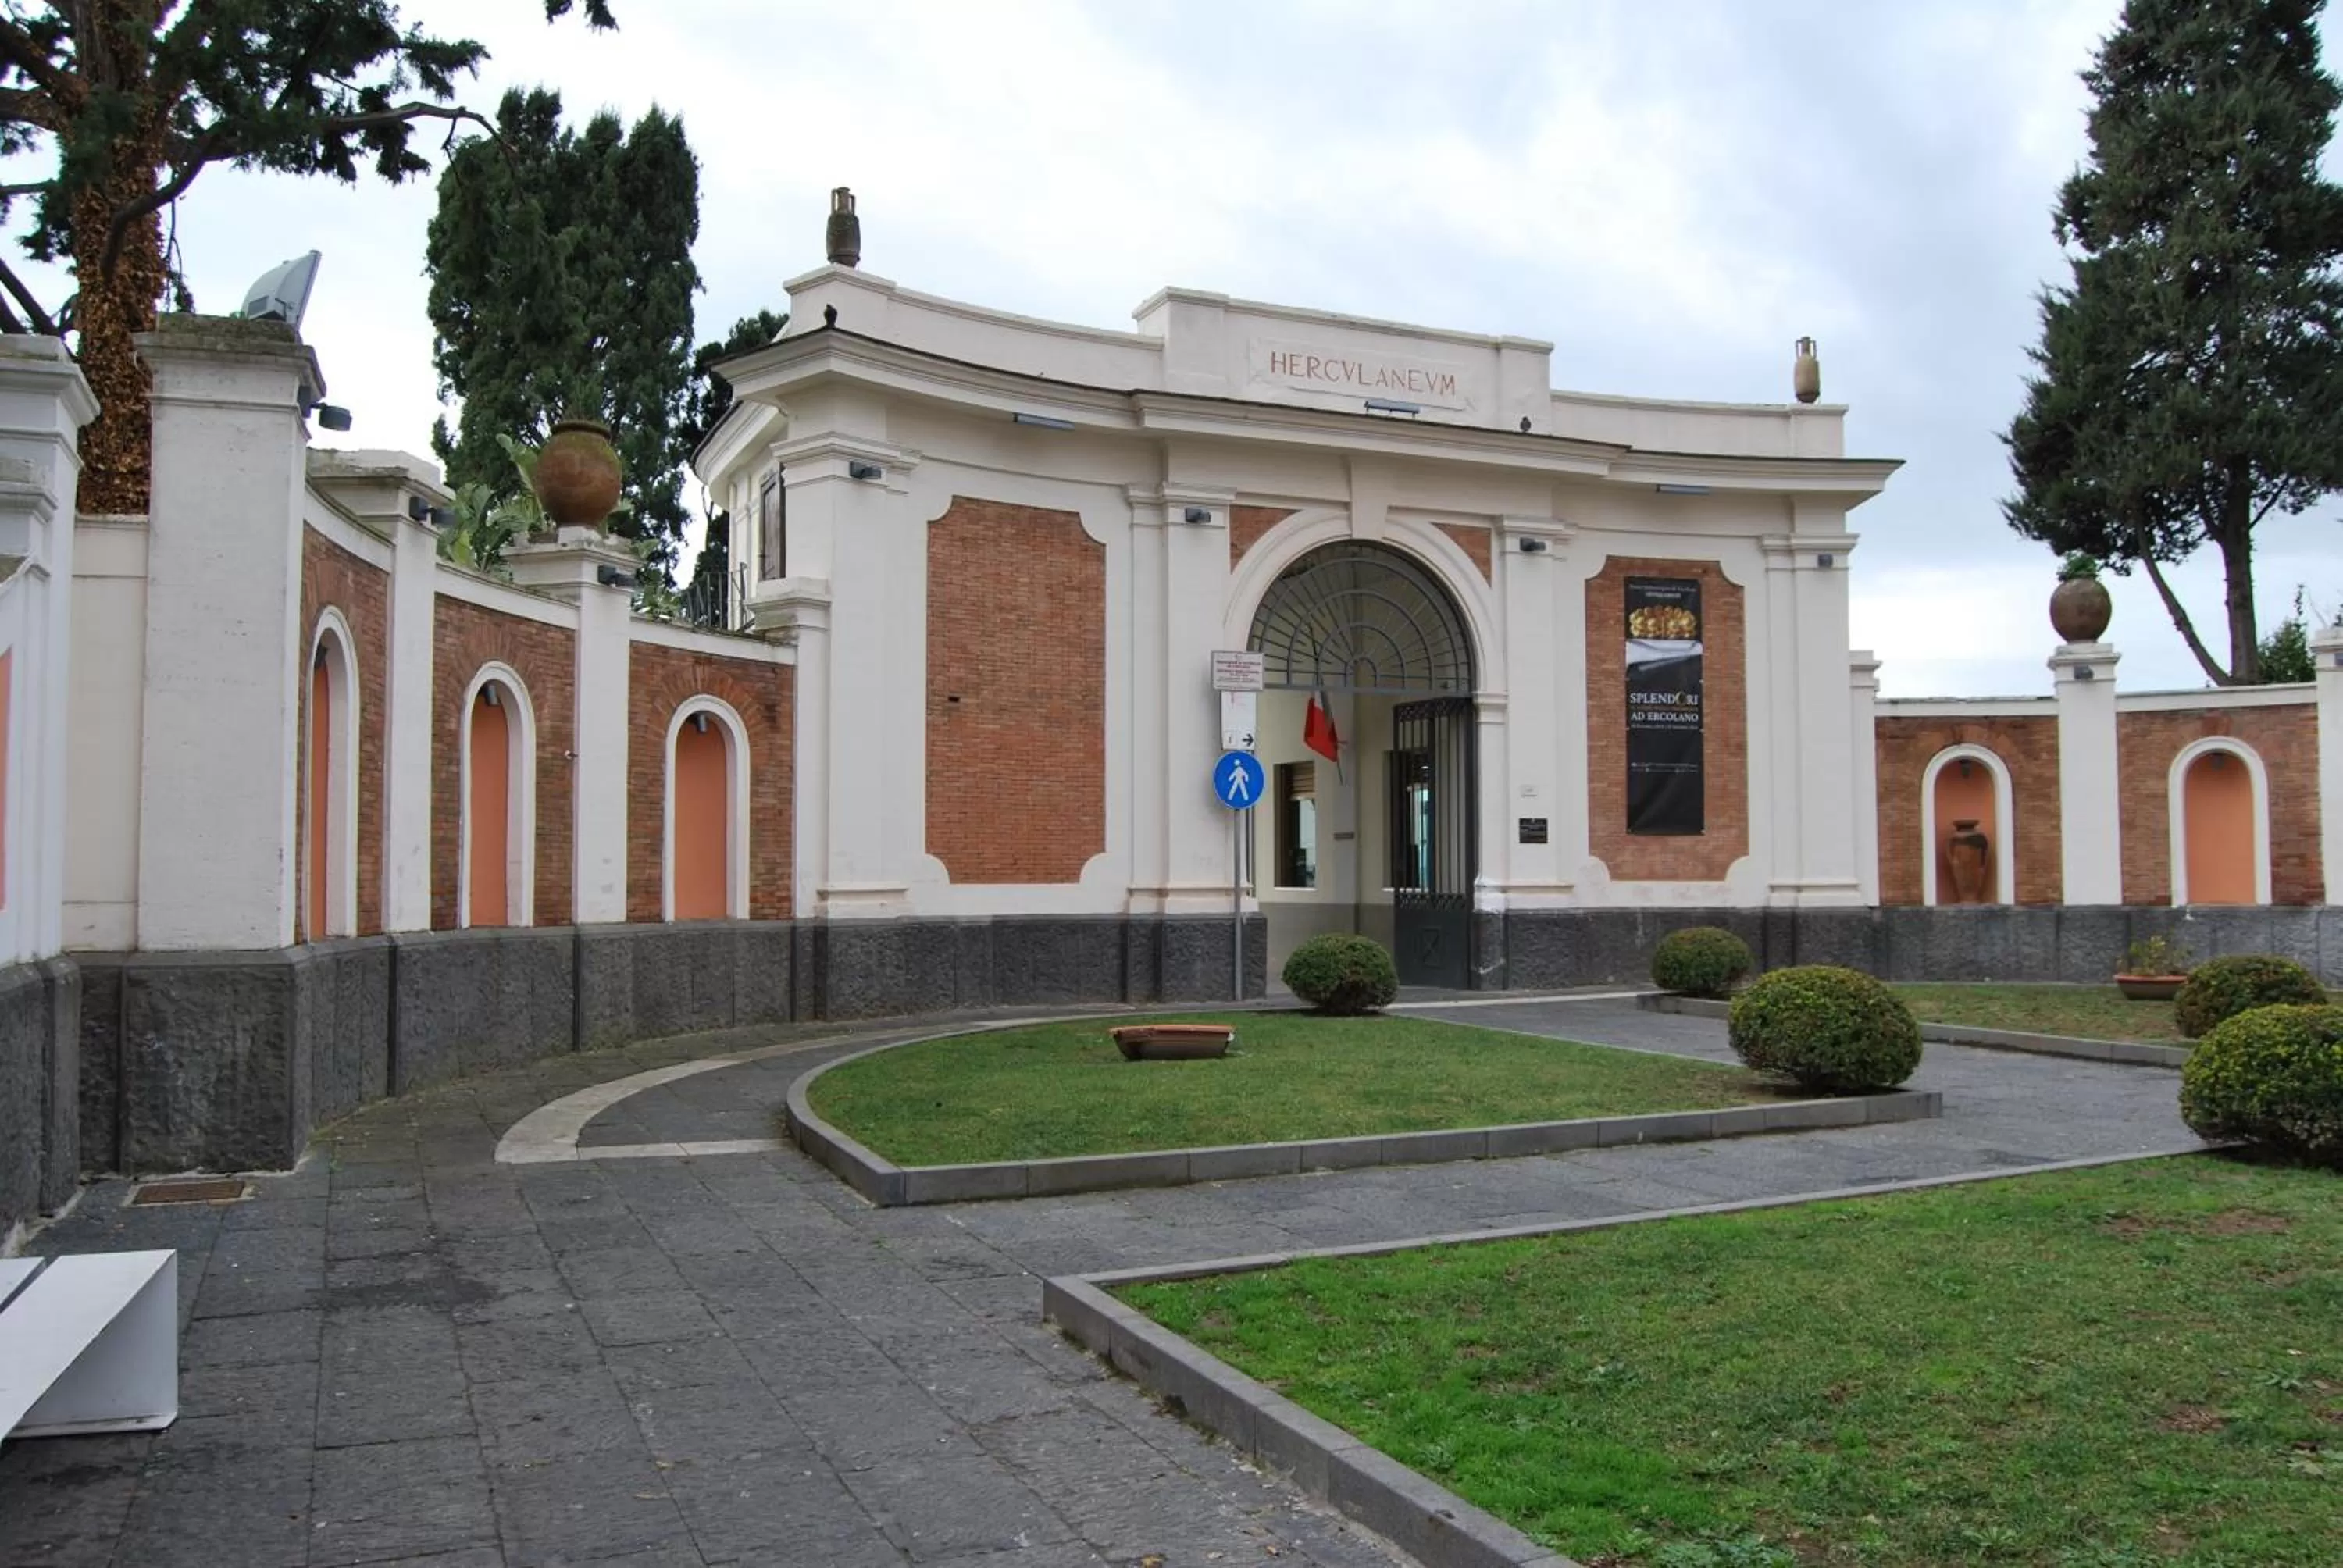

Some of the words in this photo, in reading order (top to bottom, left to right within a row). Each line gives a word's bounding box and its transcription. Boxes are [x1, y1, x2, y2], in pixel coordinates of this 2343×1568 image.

[1271, 351, 1456, 396] HERCVLANEVM
[1630, 690, 1699, 705] SPLENDORI
[1631, 711, 1646, 721] AD
[1647, 711, 1699, 722] ERCOLANO
